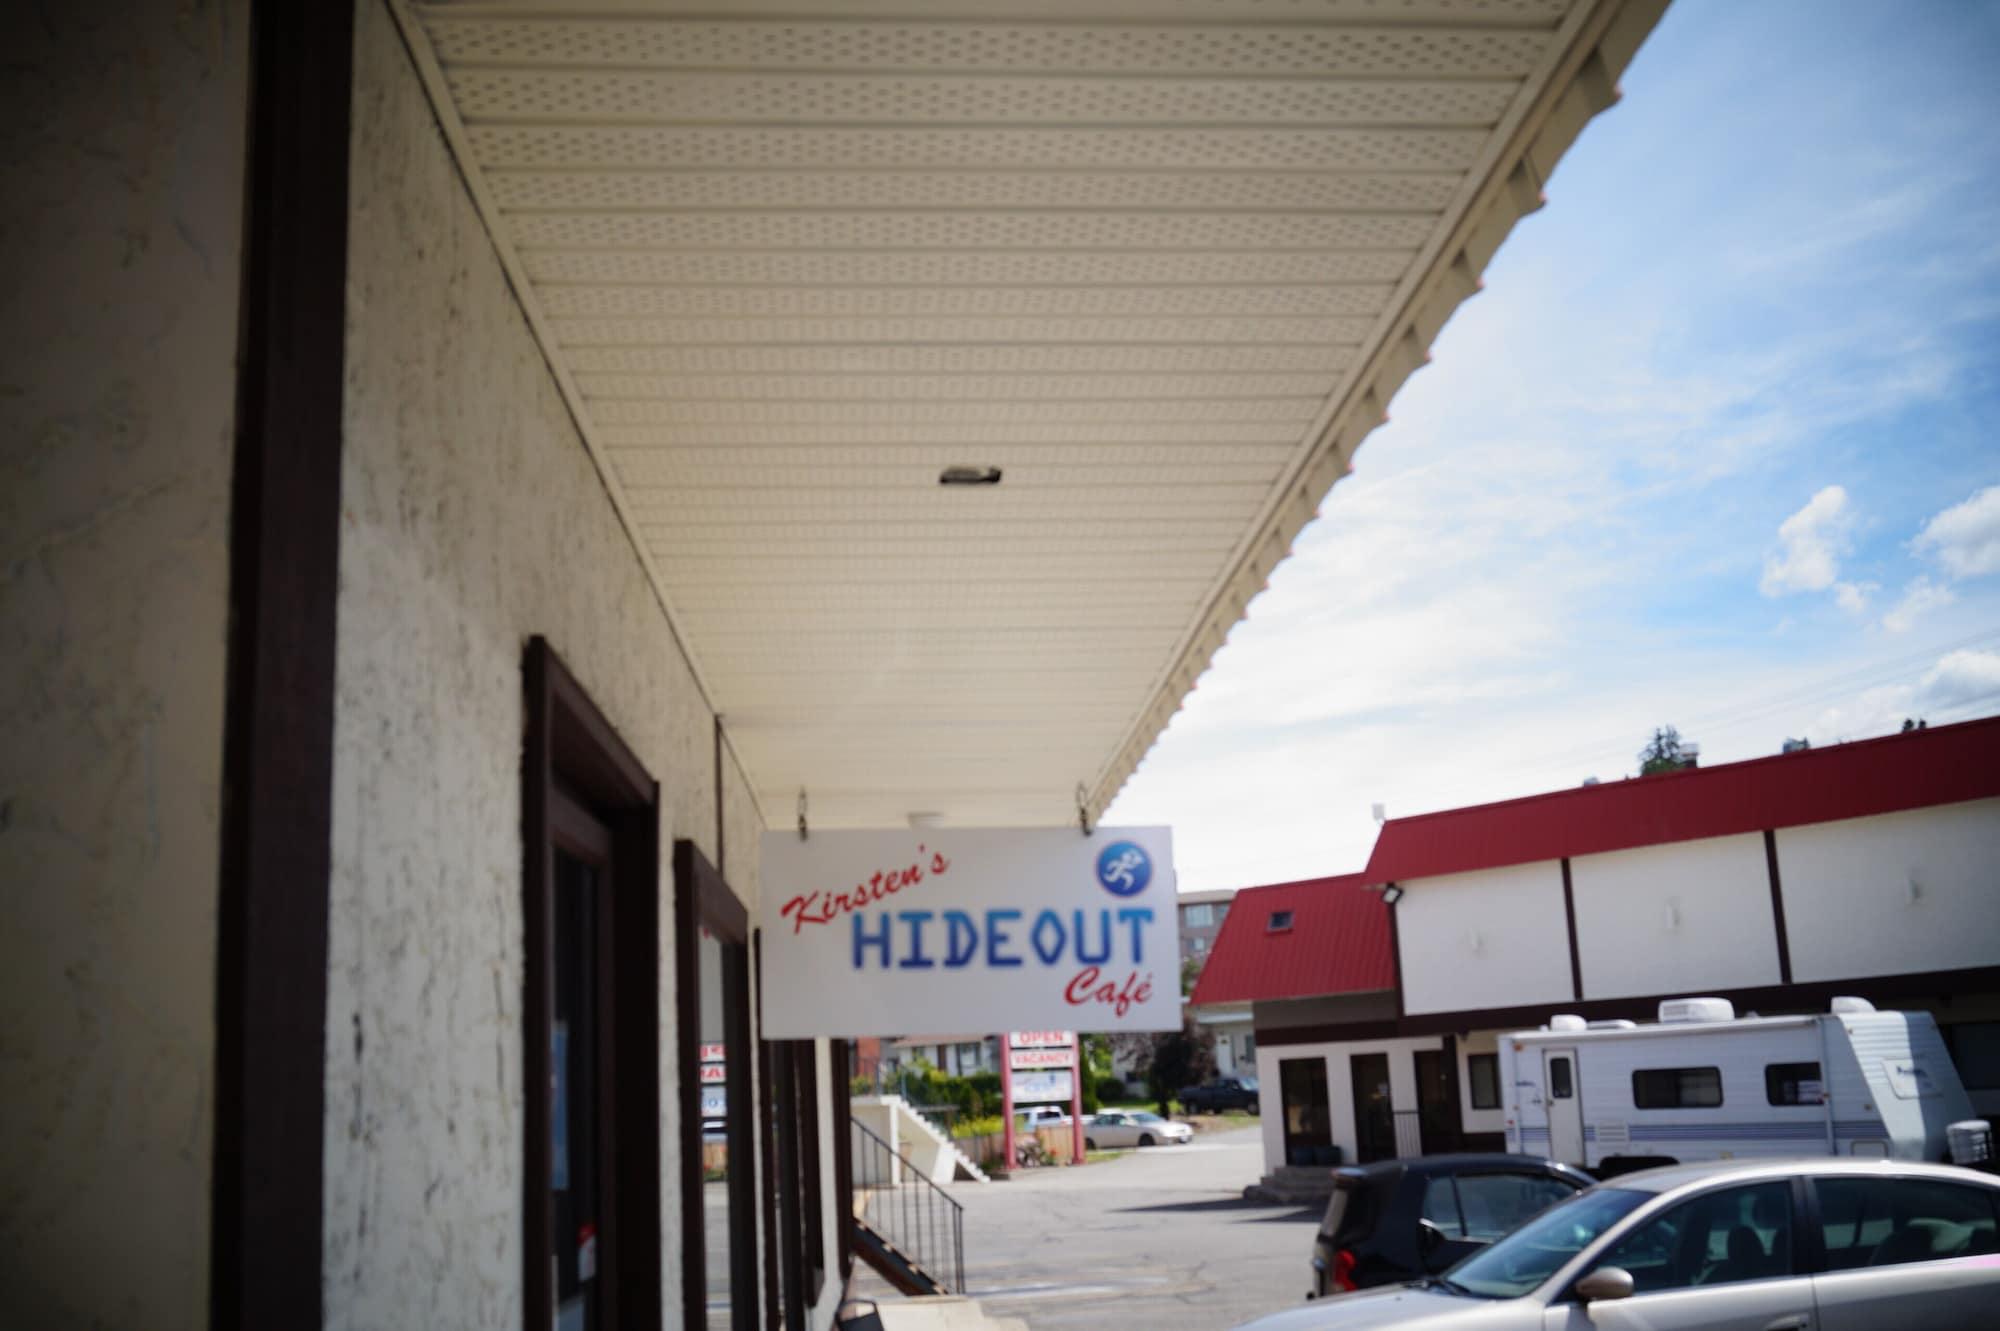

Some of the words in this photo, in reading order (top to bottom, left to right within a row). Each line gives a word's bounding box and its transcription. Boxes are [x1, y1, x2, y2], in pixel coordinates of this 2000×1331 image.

[781, 844, 949, 934] Kirsten's
[853, 908, 1154, 969] HIDEOUT
[1064, 967, 1152, 1017] Café
[1015, 1052, 1070, 1064] VACANCY
